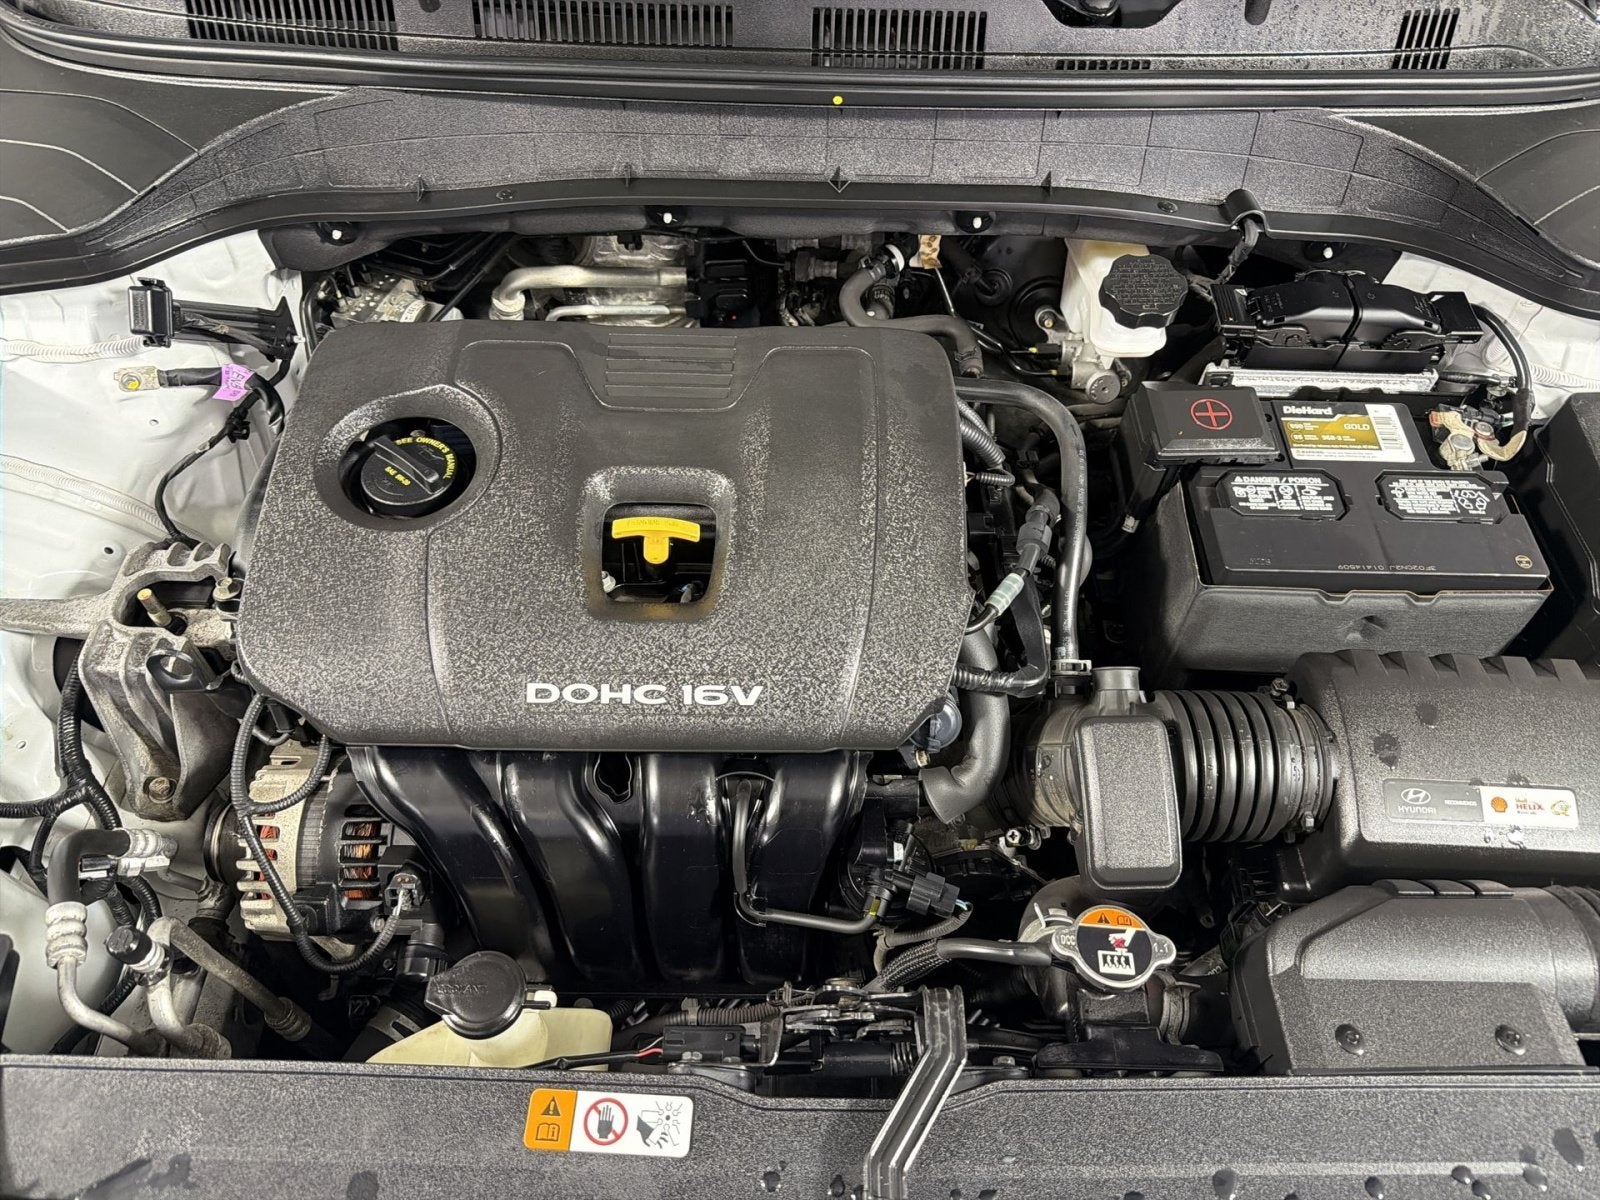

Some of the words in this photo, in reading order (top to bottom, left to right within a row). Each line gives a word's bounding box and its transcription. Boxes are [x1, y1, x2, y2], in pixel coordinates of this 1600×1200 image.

[1282, 405, 1333, 415] DieHard
[1344, 423, 1370, 431] GOLD
[396, 437, 413, 445] SEE
[416, 436, 450, 453] OWNER'S
[443, 453, 456, 479] MANUAL
[526, 682, 668, 705] DOHC
[682, 684, 764, 706] 16V
[1398, 805, 1437, 815] HYUNDAI
[1516, 803, 1544, 811] HELIX
